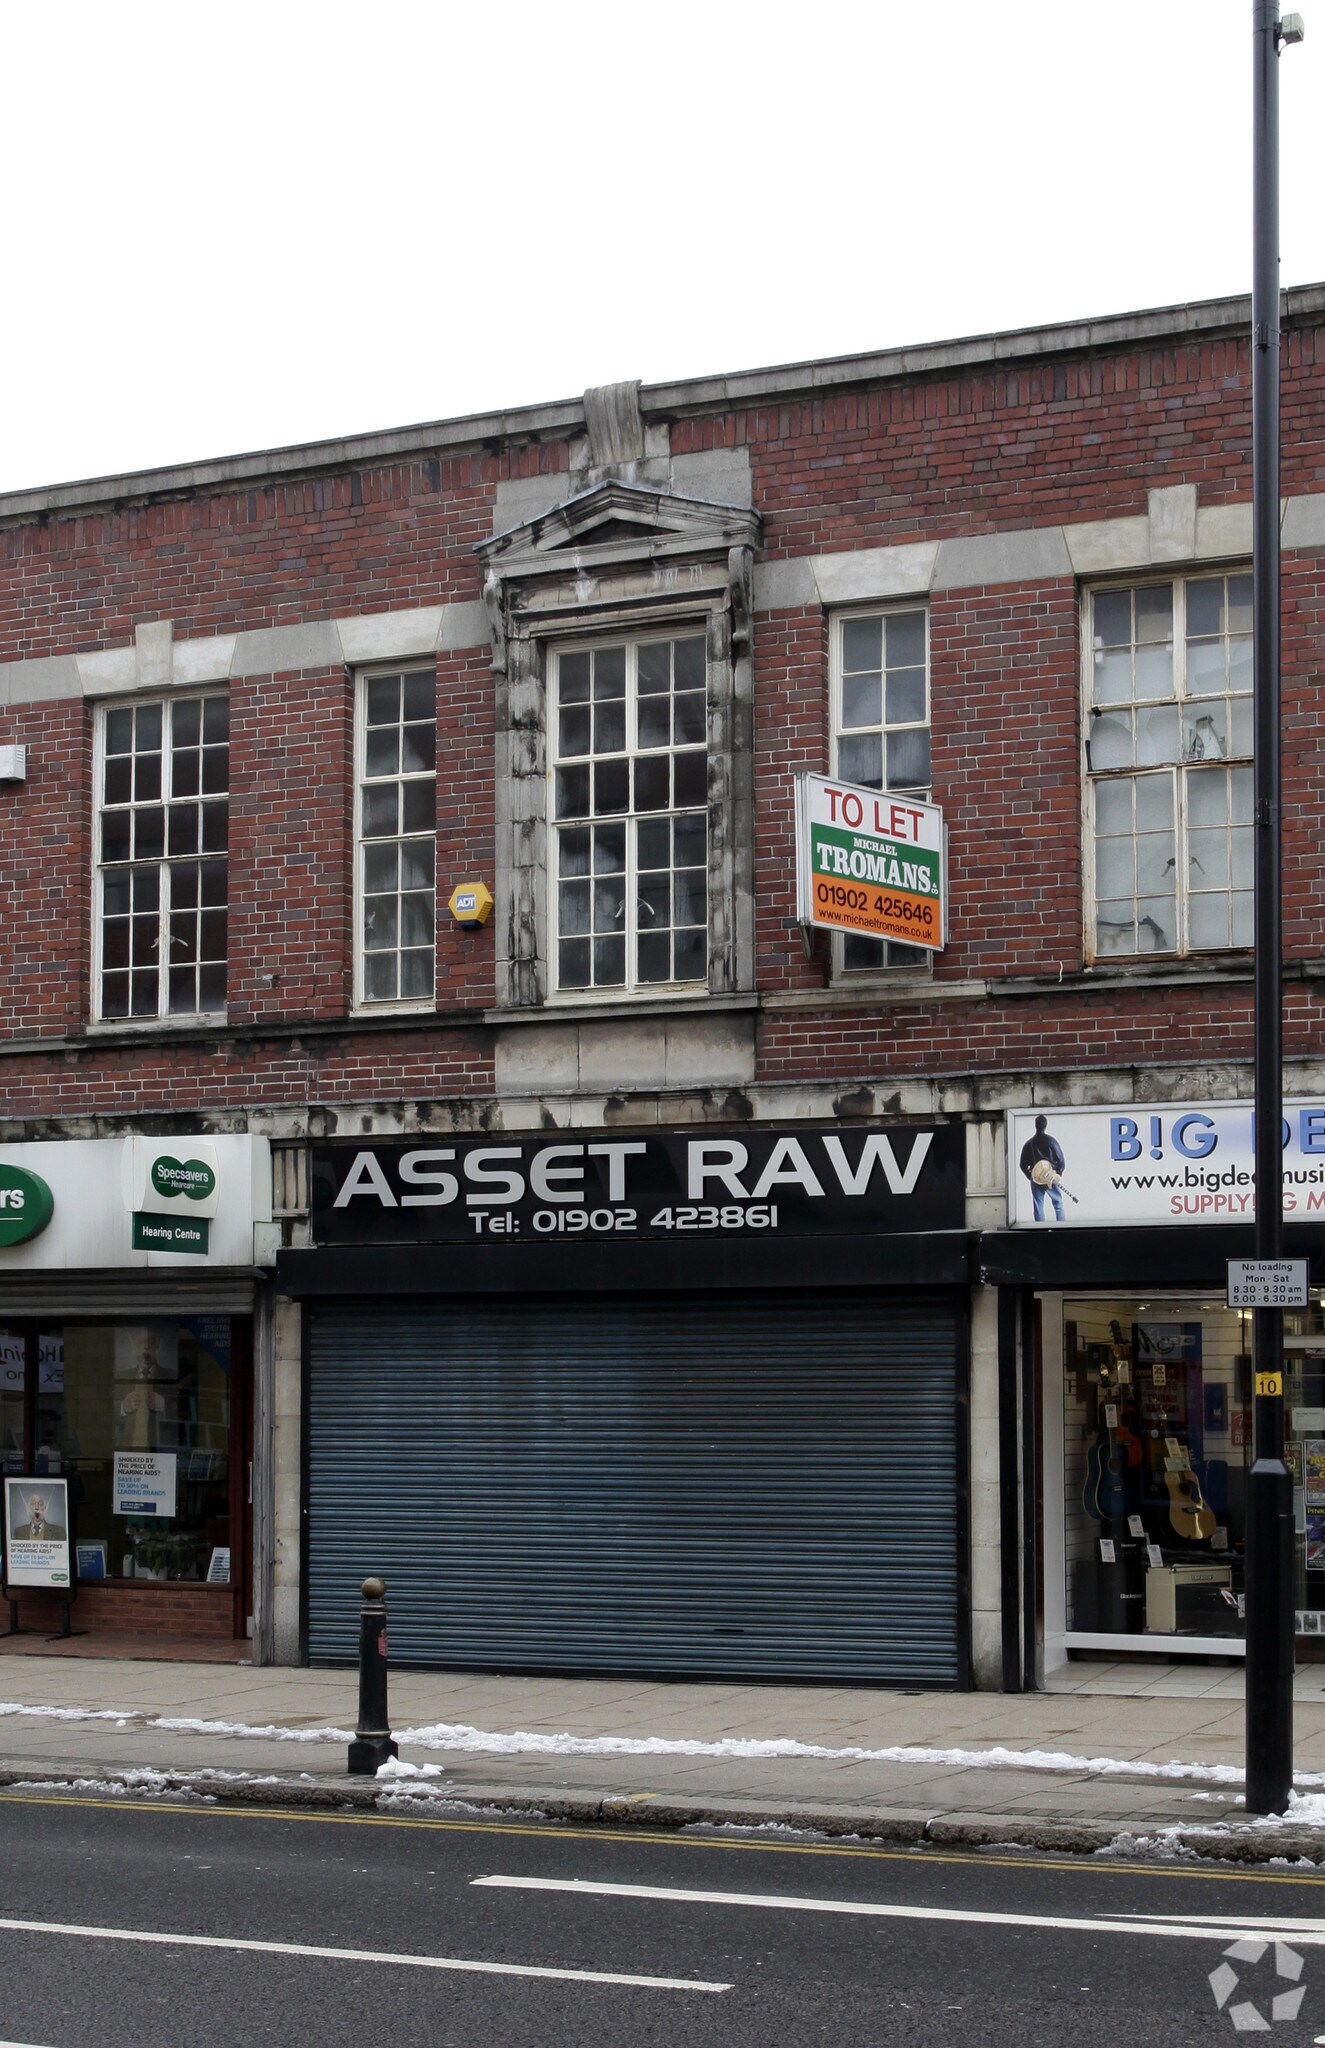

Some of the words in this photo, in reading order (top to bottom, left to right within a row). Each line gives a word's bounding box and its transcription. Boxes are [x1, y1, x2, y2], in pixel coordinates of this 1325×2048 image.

[824, 788, 863, 828] TO
[874, 801, 924, 841] LET
[853, 837, 898, 857] MICHAEL
[816, 842, 931, 894] TROMANS
[456, 897, 476, 909] ADT
[817, 883, 868, 911] 01902
[874, 896, 933, 925] 425646
[818, 908, 933, 940] www.michaeltromans.co.uk
[157, 1164, 209, 1183] Specsavers
[333, 1143, 646, 1208] ASSET
[688, 1132, 935, 1199] RAW
[171, 1180, 195, 1190] Hearcare
[468, 1211, 520, 1235] Tel:
[532, 1208, 638, 1233] 01902
[649, 1205, 779, 1231] 423861
[142, 1225, 173, 1240] Hearing
[175, 1228, 201, 1240] Centre
[1242, 1263, 1256, 1271] No
[1258, 1262, 1293, 1273] loading
[1245, 1275, 1266, 1283] Mon
[1273, 1275, 1290, 1283] Sat
[1233, 1285, 1256, 1294] 8.30
[1263, 1285, 1286, 1294] 9.30
[1233, 1295, 1256, 1303] 5.00
[1263, 1295, 1286, 1303] 6.30
[1288, 1296, 1303, 1304] pm
[1259, 1380, 1277, 1395] 10
